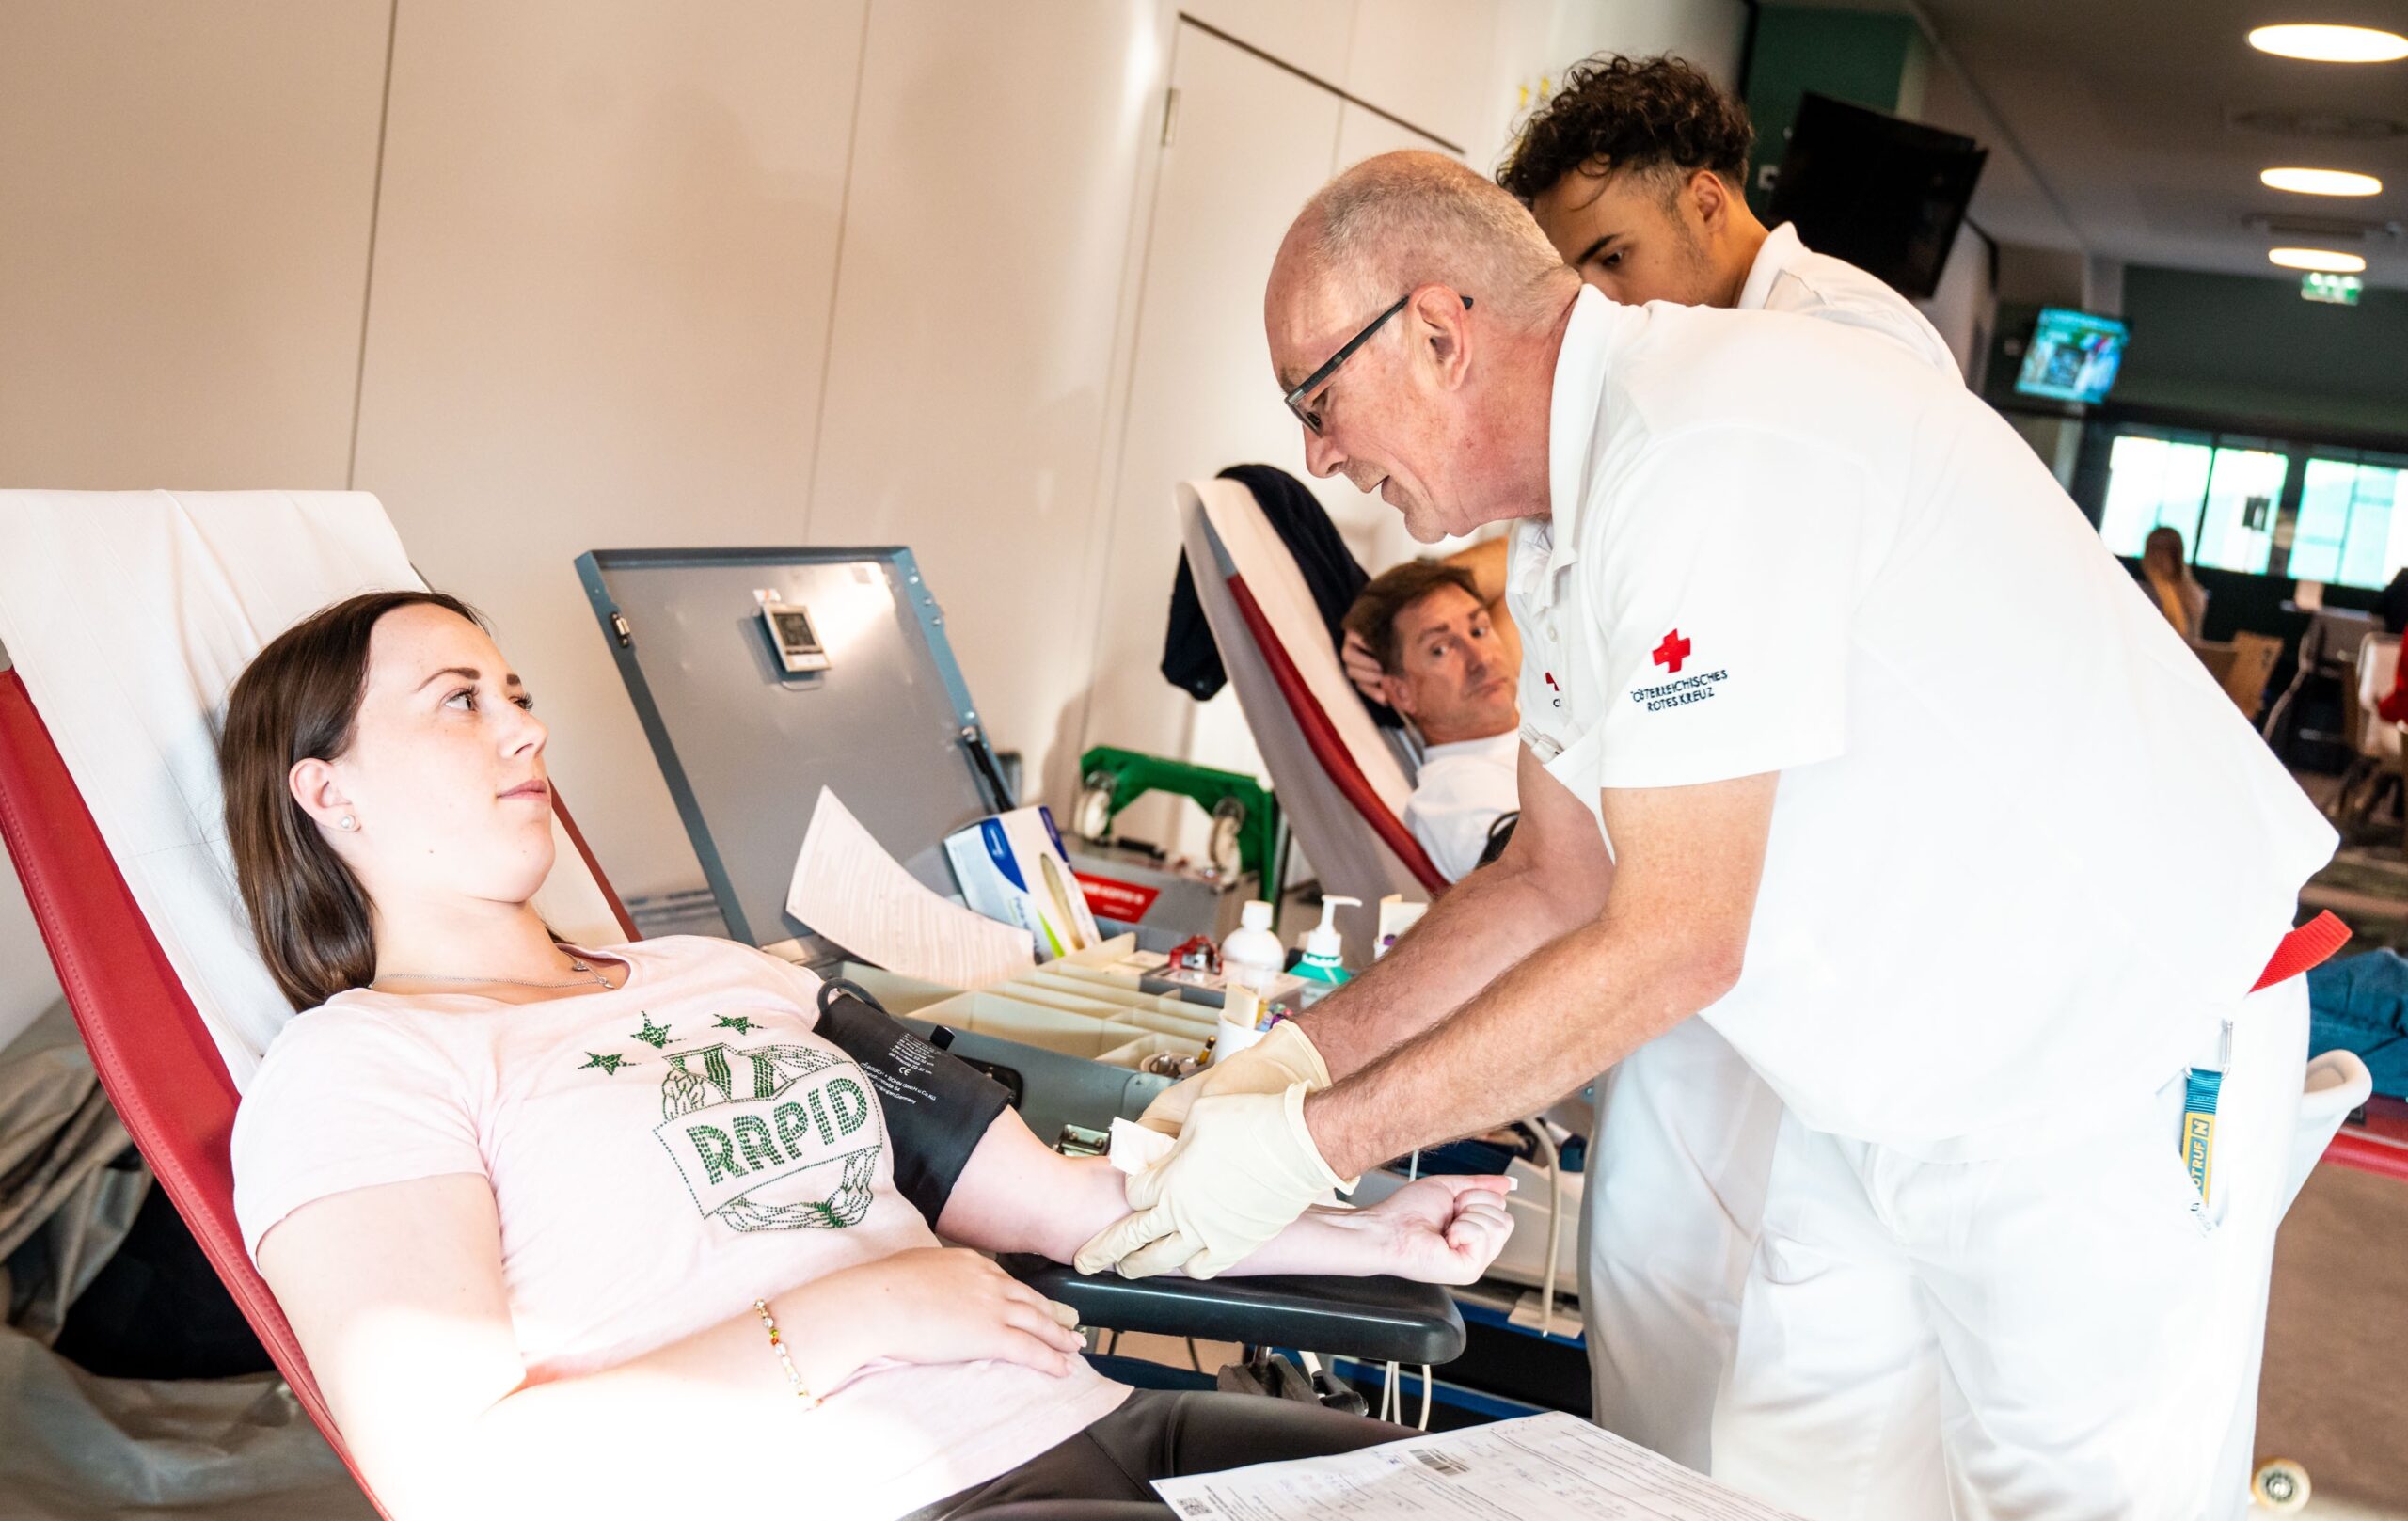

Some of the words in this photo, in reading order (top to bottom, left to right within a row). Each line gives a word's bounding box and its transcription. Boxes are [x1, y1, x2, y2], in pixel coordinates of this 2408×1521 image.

[1647, 696, 1678, 712] ROTES
[1679, 687, 1715, 705] KREUZ
[686, 1077, 868, 1186] RAPID
[2191, 1141, 2205, 1188] OTRUF
